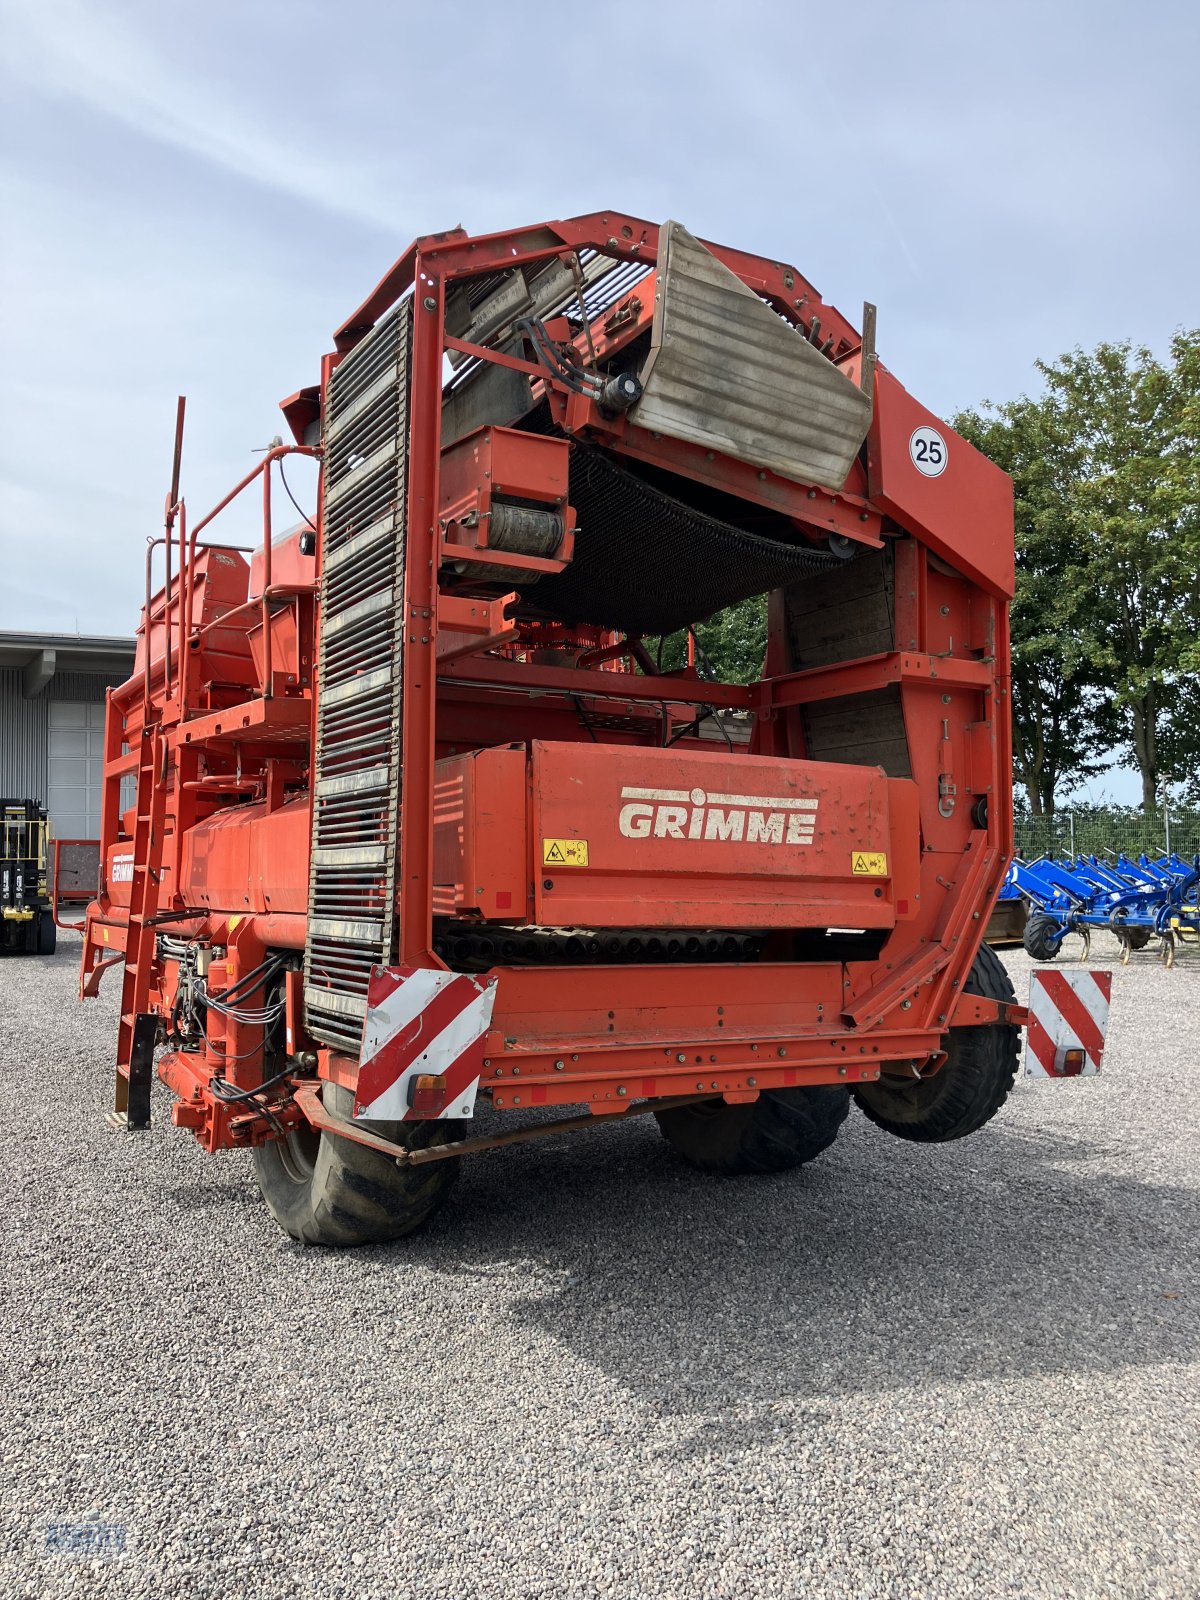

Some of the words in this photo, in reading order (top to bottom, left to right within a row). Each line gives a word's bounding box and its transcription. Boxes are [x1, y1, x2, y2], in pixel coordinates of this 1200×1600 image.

[915, 438, 942, 464] 25
[618, 802, 817, 845] GRIMME
[112, 863, 134, 882] GRIMM
